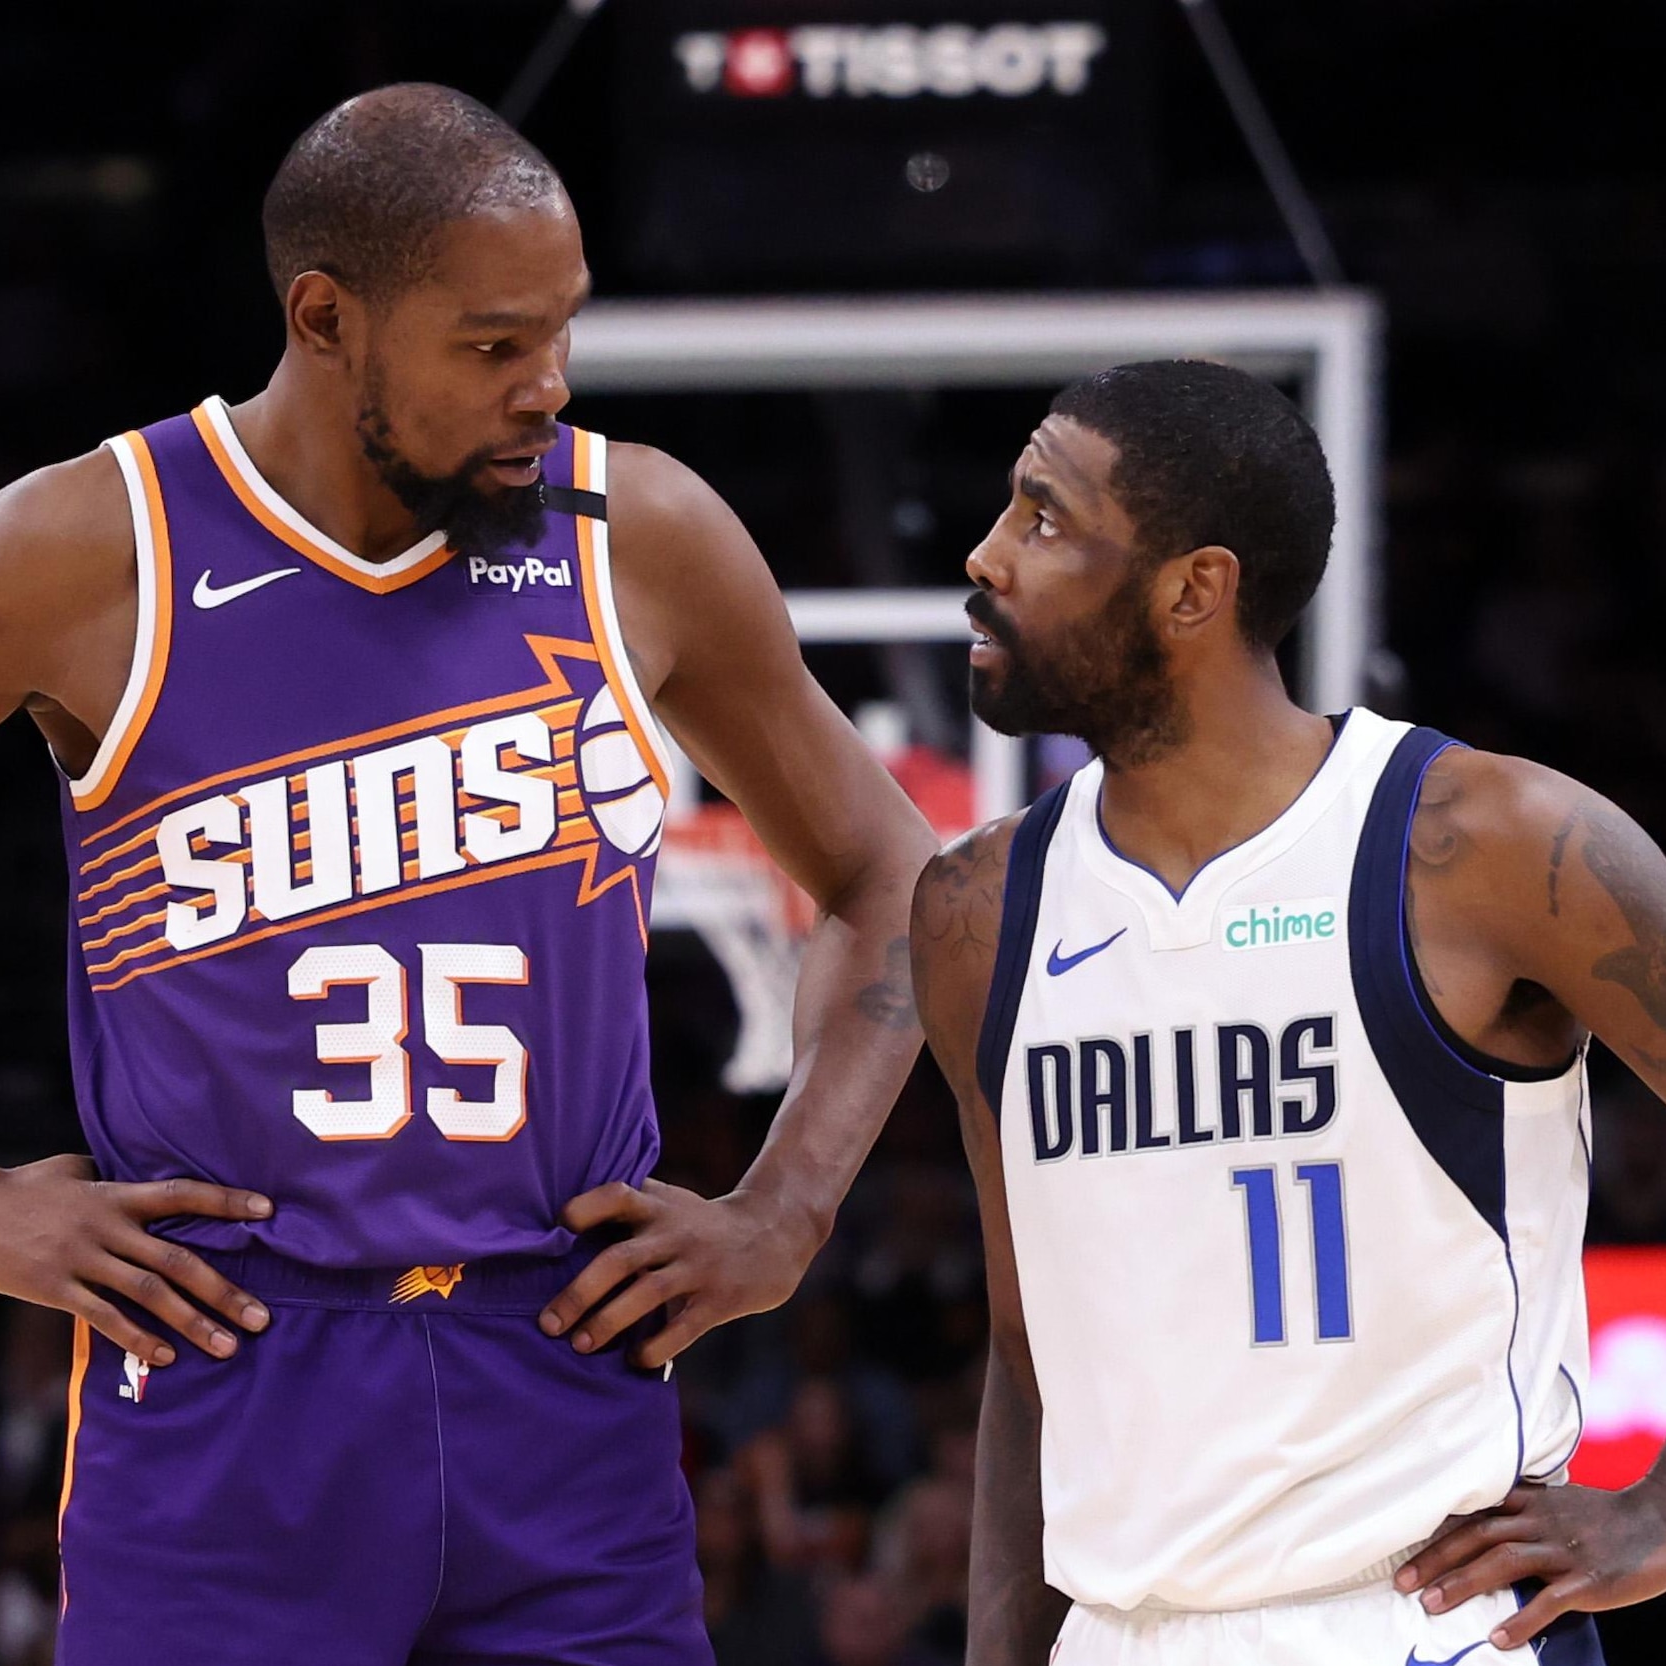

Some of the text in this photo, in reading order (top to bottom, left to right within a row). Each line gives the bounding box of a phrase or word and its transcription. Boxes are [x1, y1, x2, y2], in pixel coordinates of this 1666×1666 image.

[790, 22, 1106, 97] TISSOT
[468, 556, 572, 592] PayPal
[155, 711, 557, 950] SUNS
[1225, 906, 1335, 947] chime
[287, 943, 529, 1143] 35
[1024, 1011, 1340, 1166] DALLAS
[1228, 1158, 1355, 1349] 11
